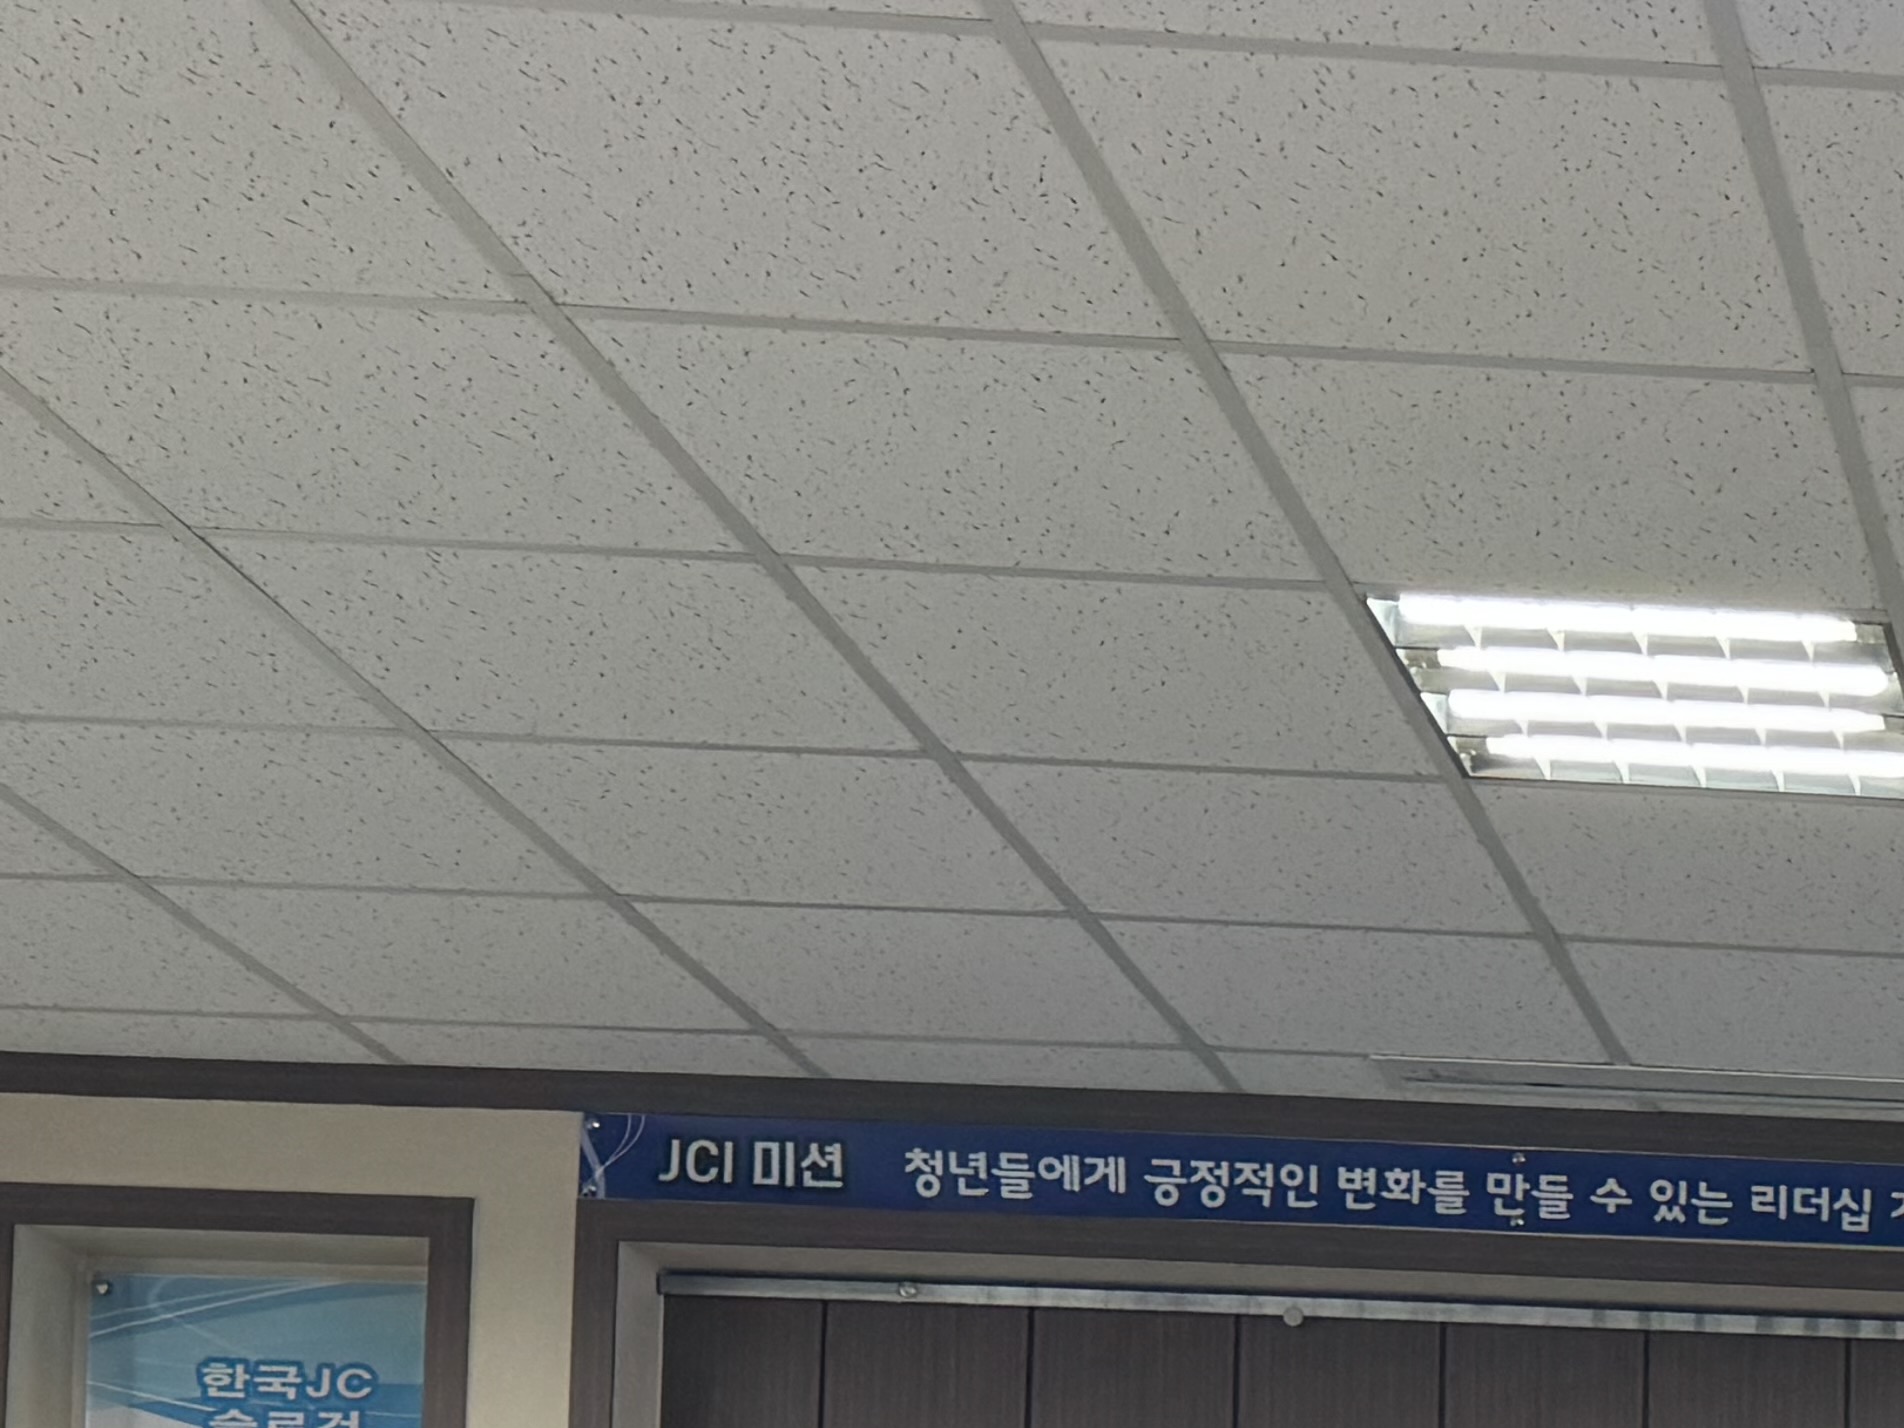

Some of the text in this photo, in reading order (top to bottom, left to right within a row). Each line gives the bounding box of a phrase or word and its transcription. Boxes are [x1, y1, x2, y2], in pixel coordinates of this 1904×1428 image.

[659, 1139, 843, 1189] JCI 미션
[904, 1147, 1127, 1199] 청년들에게
[1143, 1159, 1320, 1208] 긍정적인
[1336, 1166, 1470, 1215] 변화를
[1486, 1171, 1574, 1221] 만들
[1589, 1181, 1633, 1219] 수
[1650, 1179, 1733, 1226] 있는
[1751, 1184, 1871, 1233] 리더십
[200, 1361, 374, 1400] 한국JC
